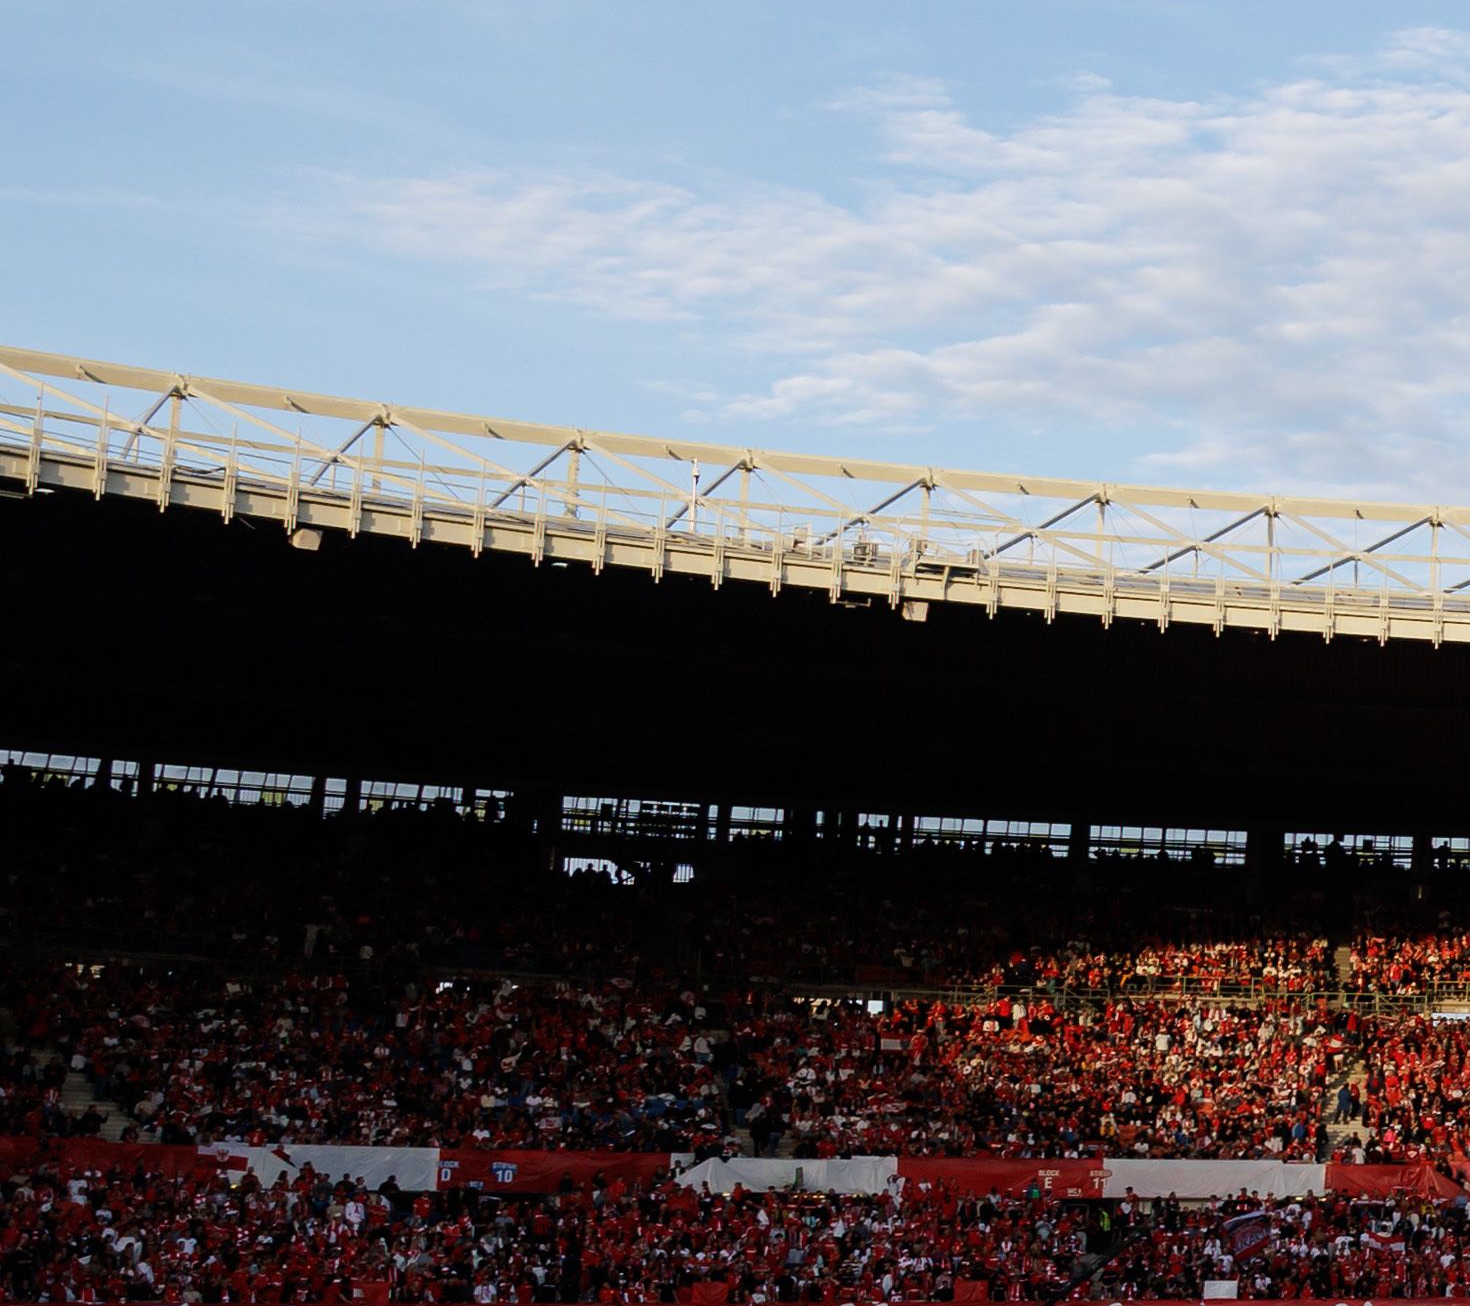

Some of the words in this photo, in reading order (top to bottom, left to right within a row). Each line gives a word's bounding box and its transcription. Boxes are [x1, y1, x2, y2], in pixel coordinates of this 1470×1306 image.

[495, 1169, 514, 1183] 10
[1044, 1176, 1053, 1189] E
[1092, 1177, 1107, 1190] 11
